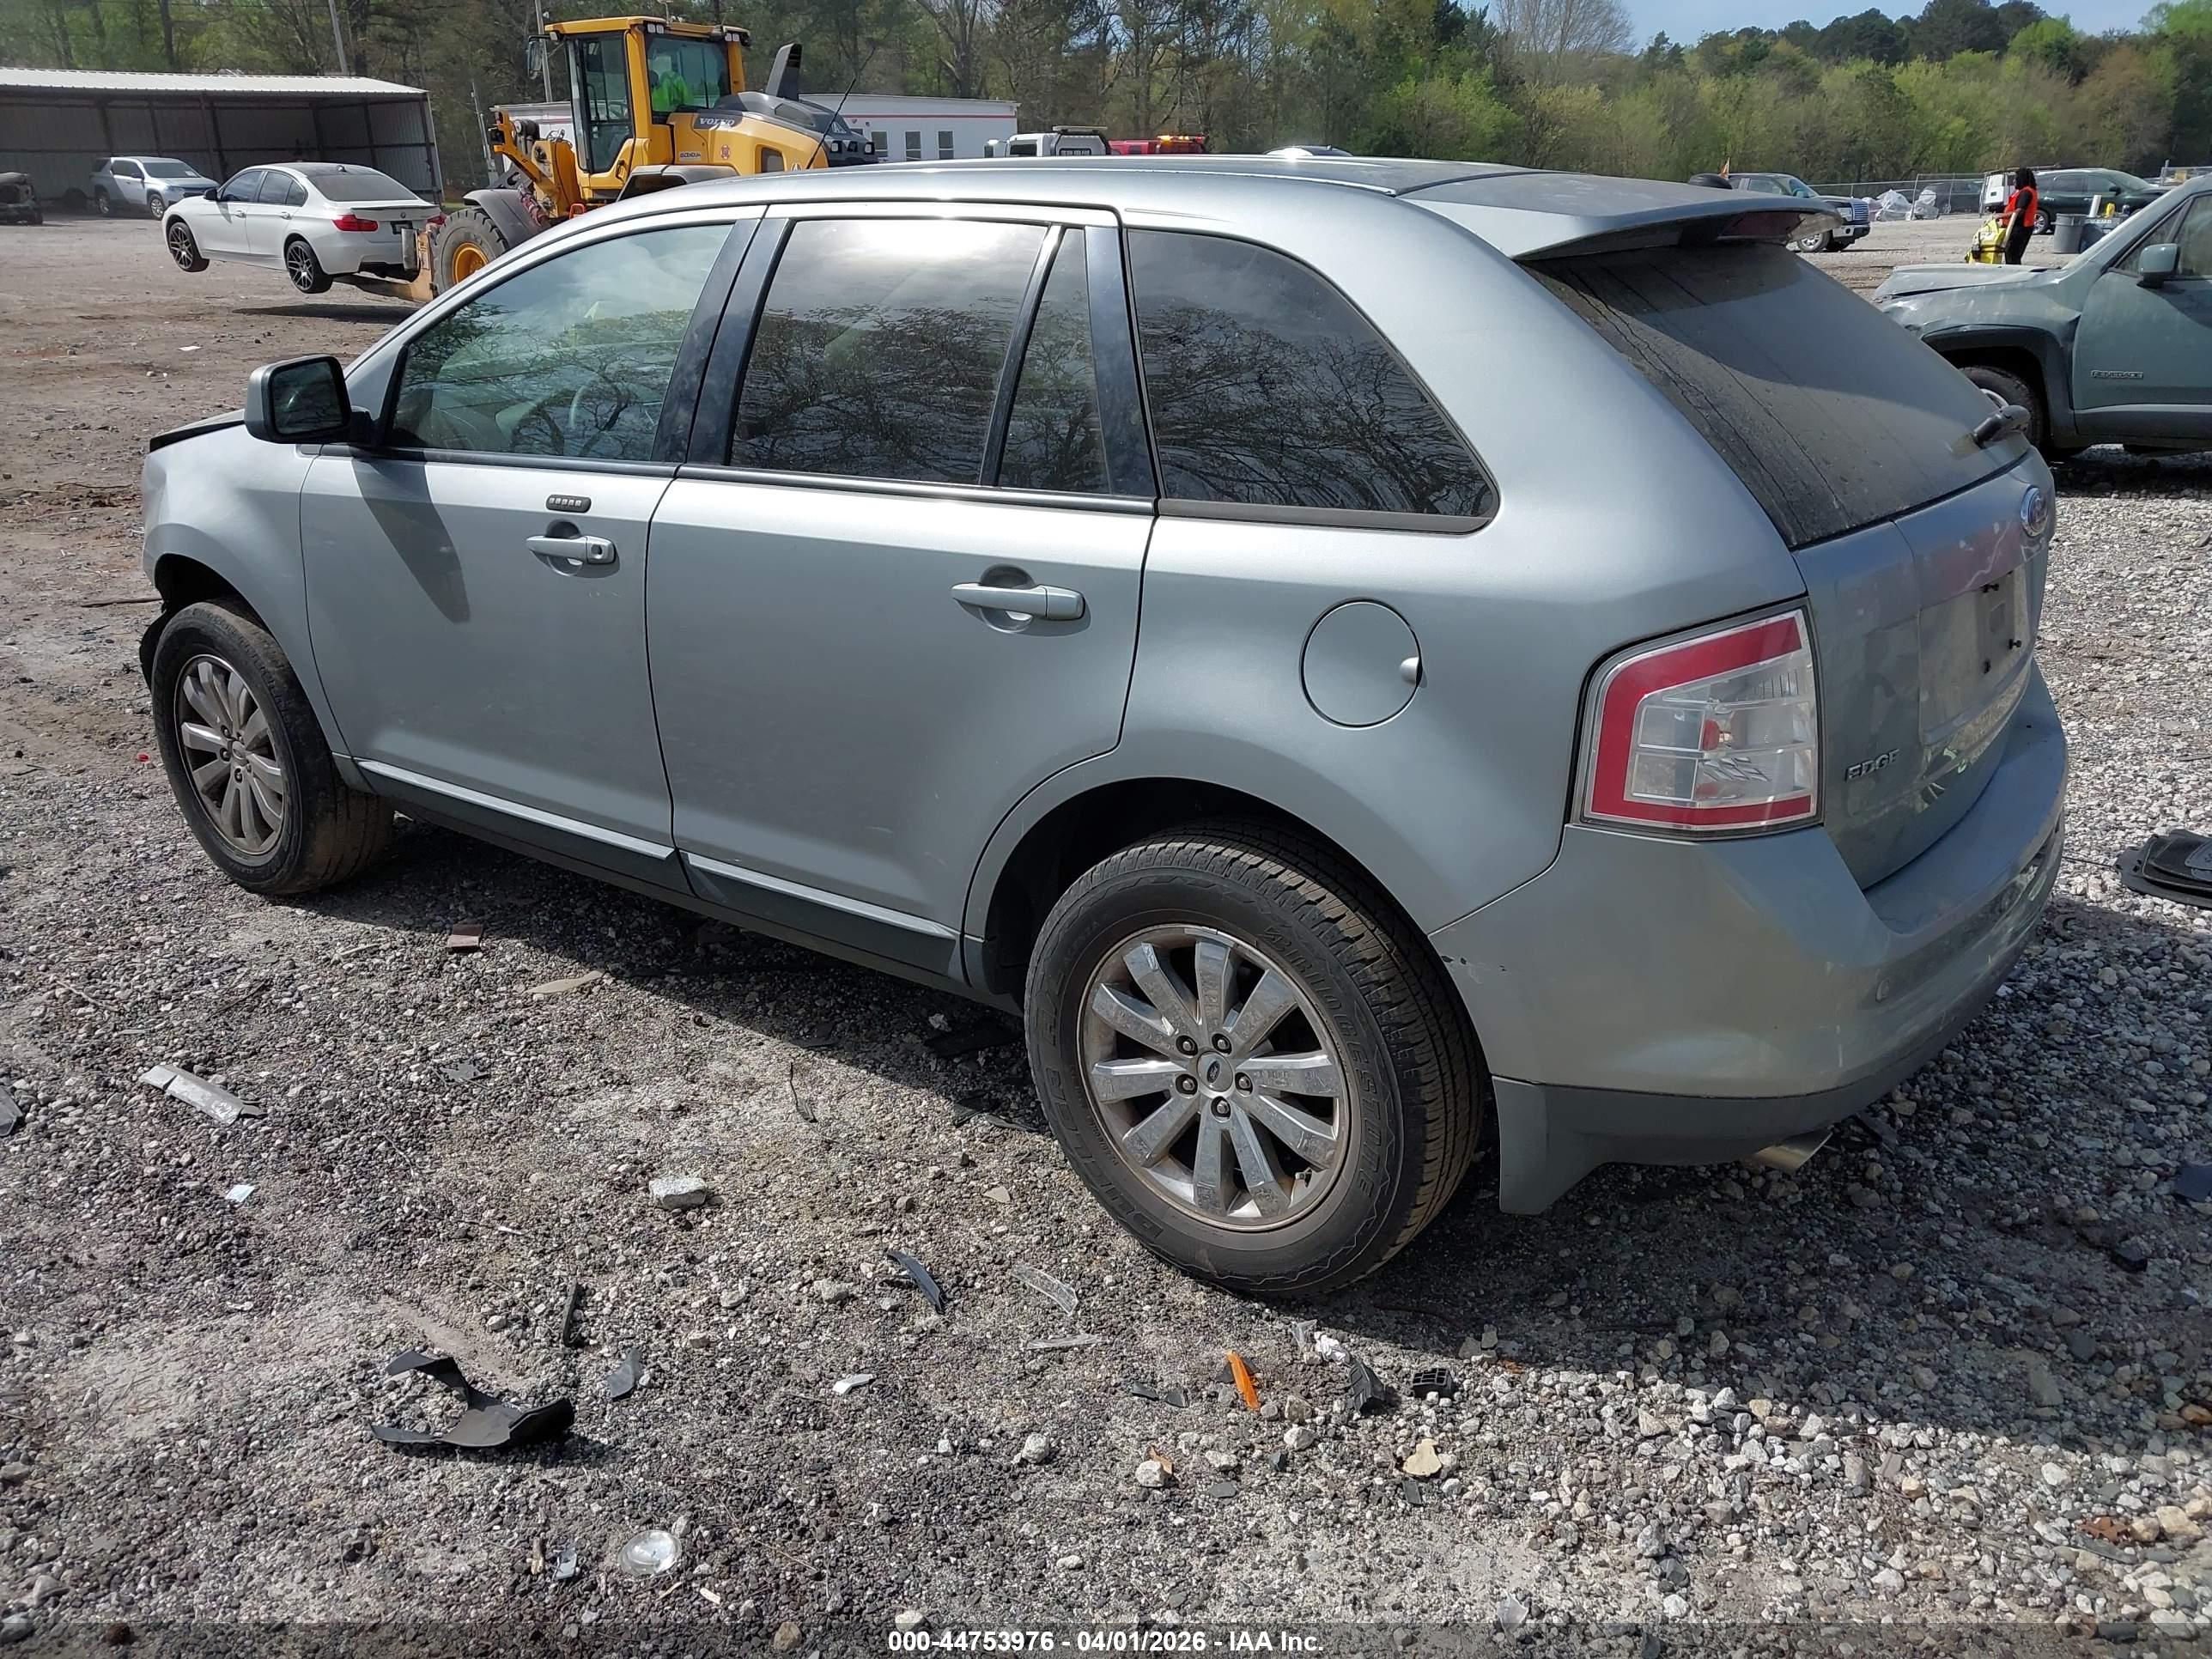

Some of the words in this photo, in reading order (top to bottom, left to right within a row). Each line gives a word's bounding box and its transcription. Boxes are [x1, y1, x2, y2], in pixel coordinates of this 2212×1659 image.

[699, 118, 735, 126] VOLVO
[1844, 750, 1900, 781] EDGE
[1260, 921, 1383, 1194] BRIDGESTONE
